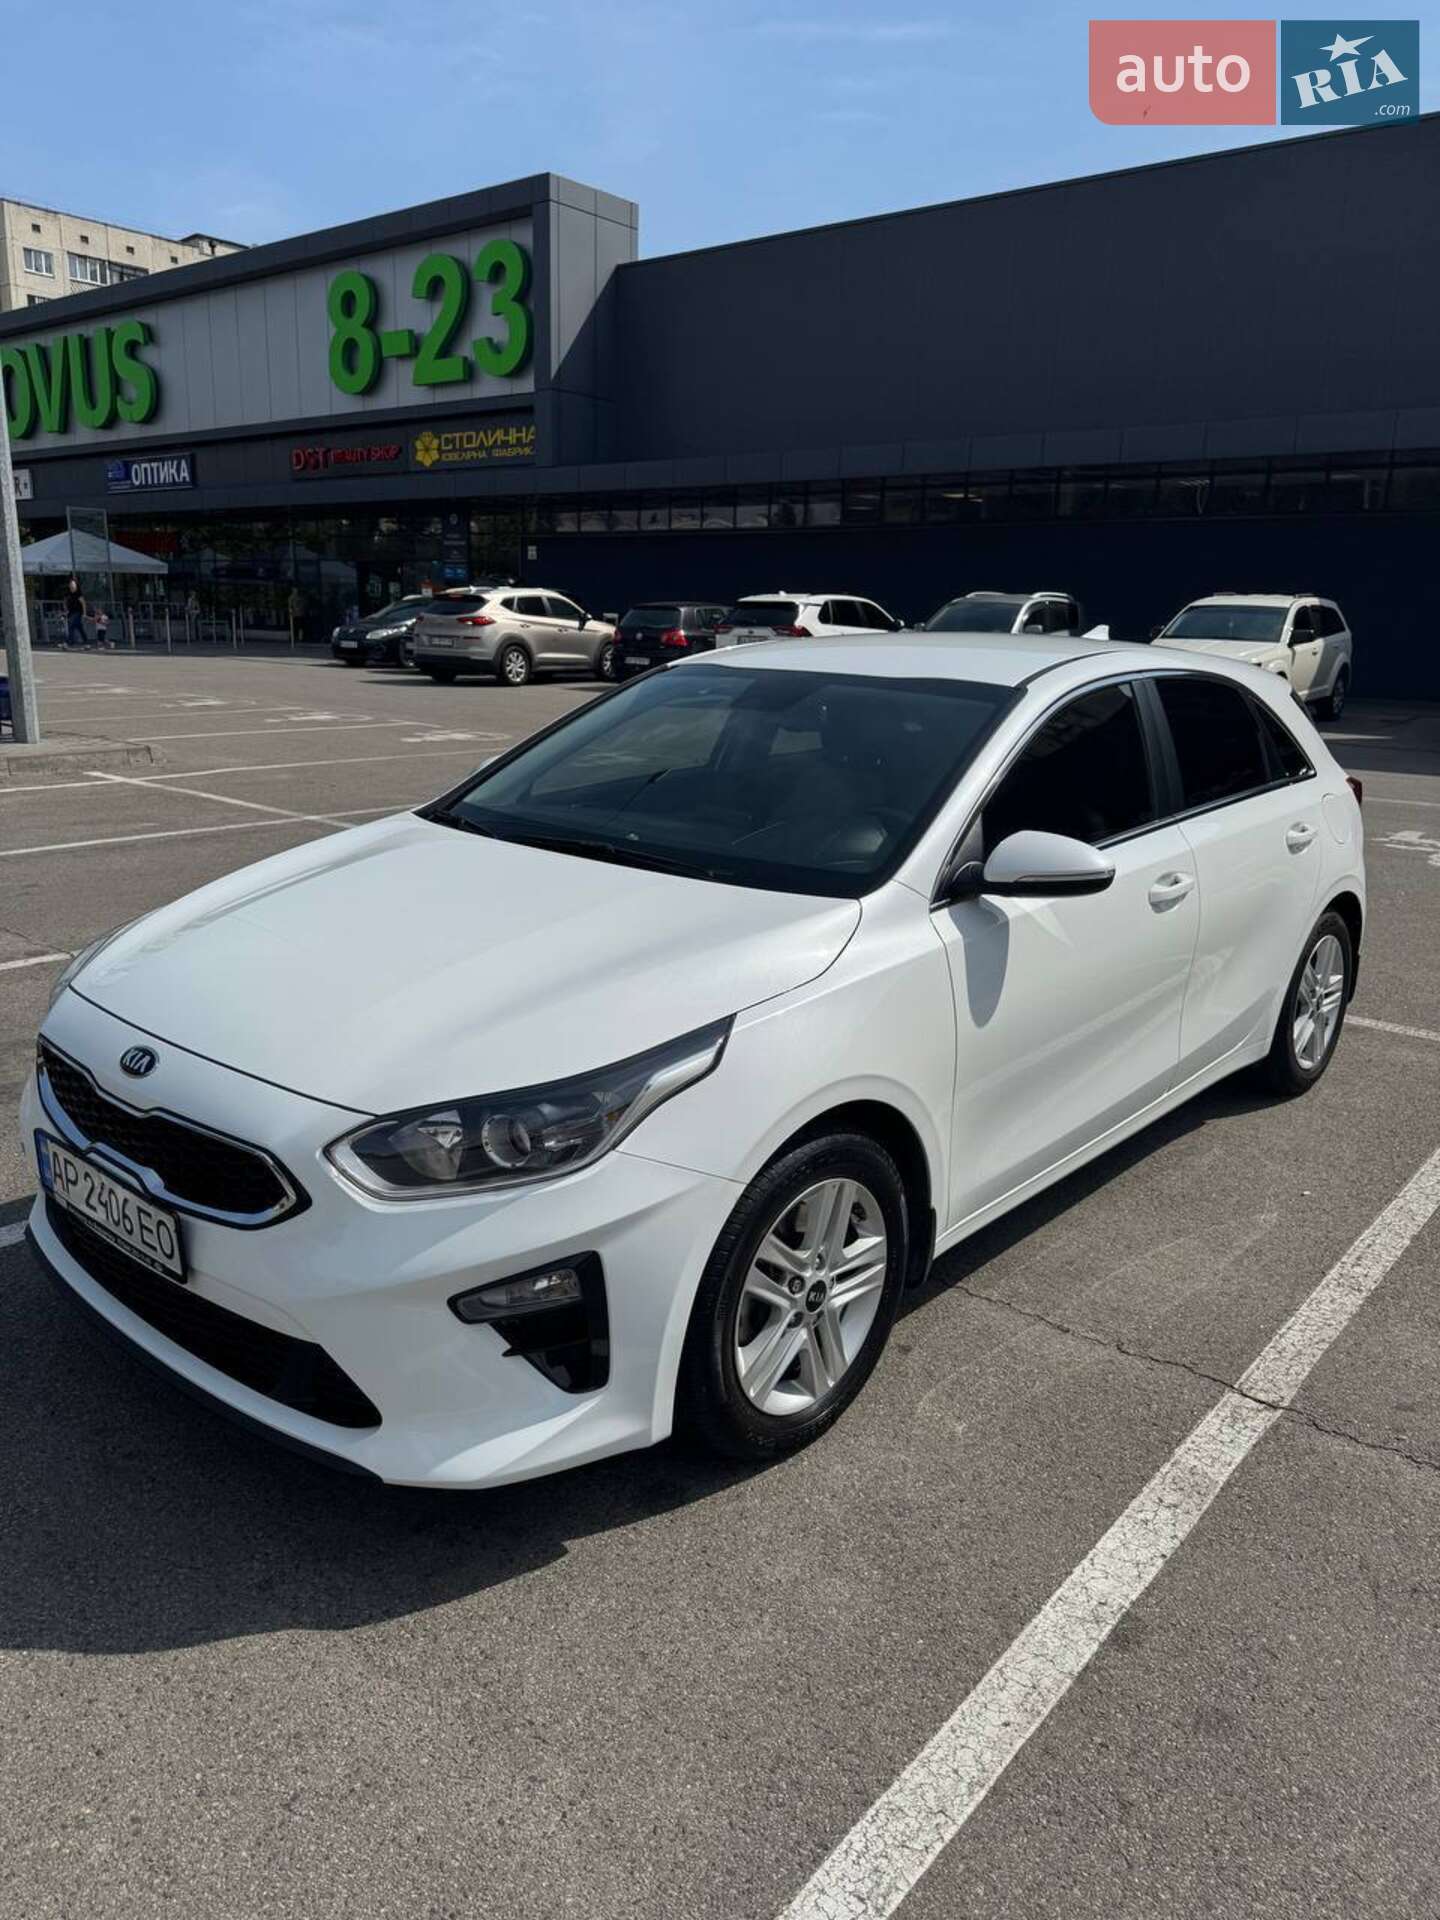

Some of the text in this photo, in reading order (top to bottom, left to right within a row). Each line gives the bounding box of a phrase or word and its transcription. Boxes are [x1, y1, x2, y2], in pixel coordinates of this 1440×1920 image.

[328, 238, 533, 394] 8-23
[131, 458, 191, 486] ОПТИКА
[122, 1049, 151, 1072] KIA
[52, 1151, 79, 1194] AP
[83, 1171, 134, 1236] 2406
[136, 1205, 175, 1261] EO
